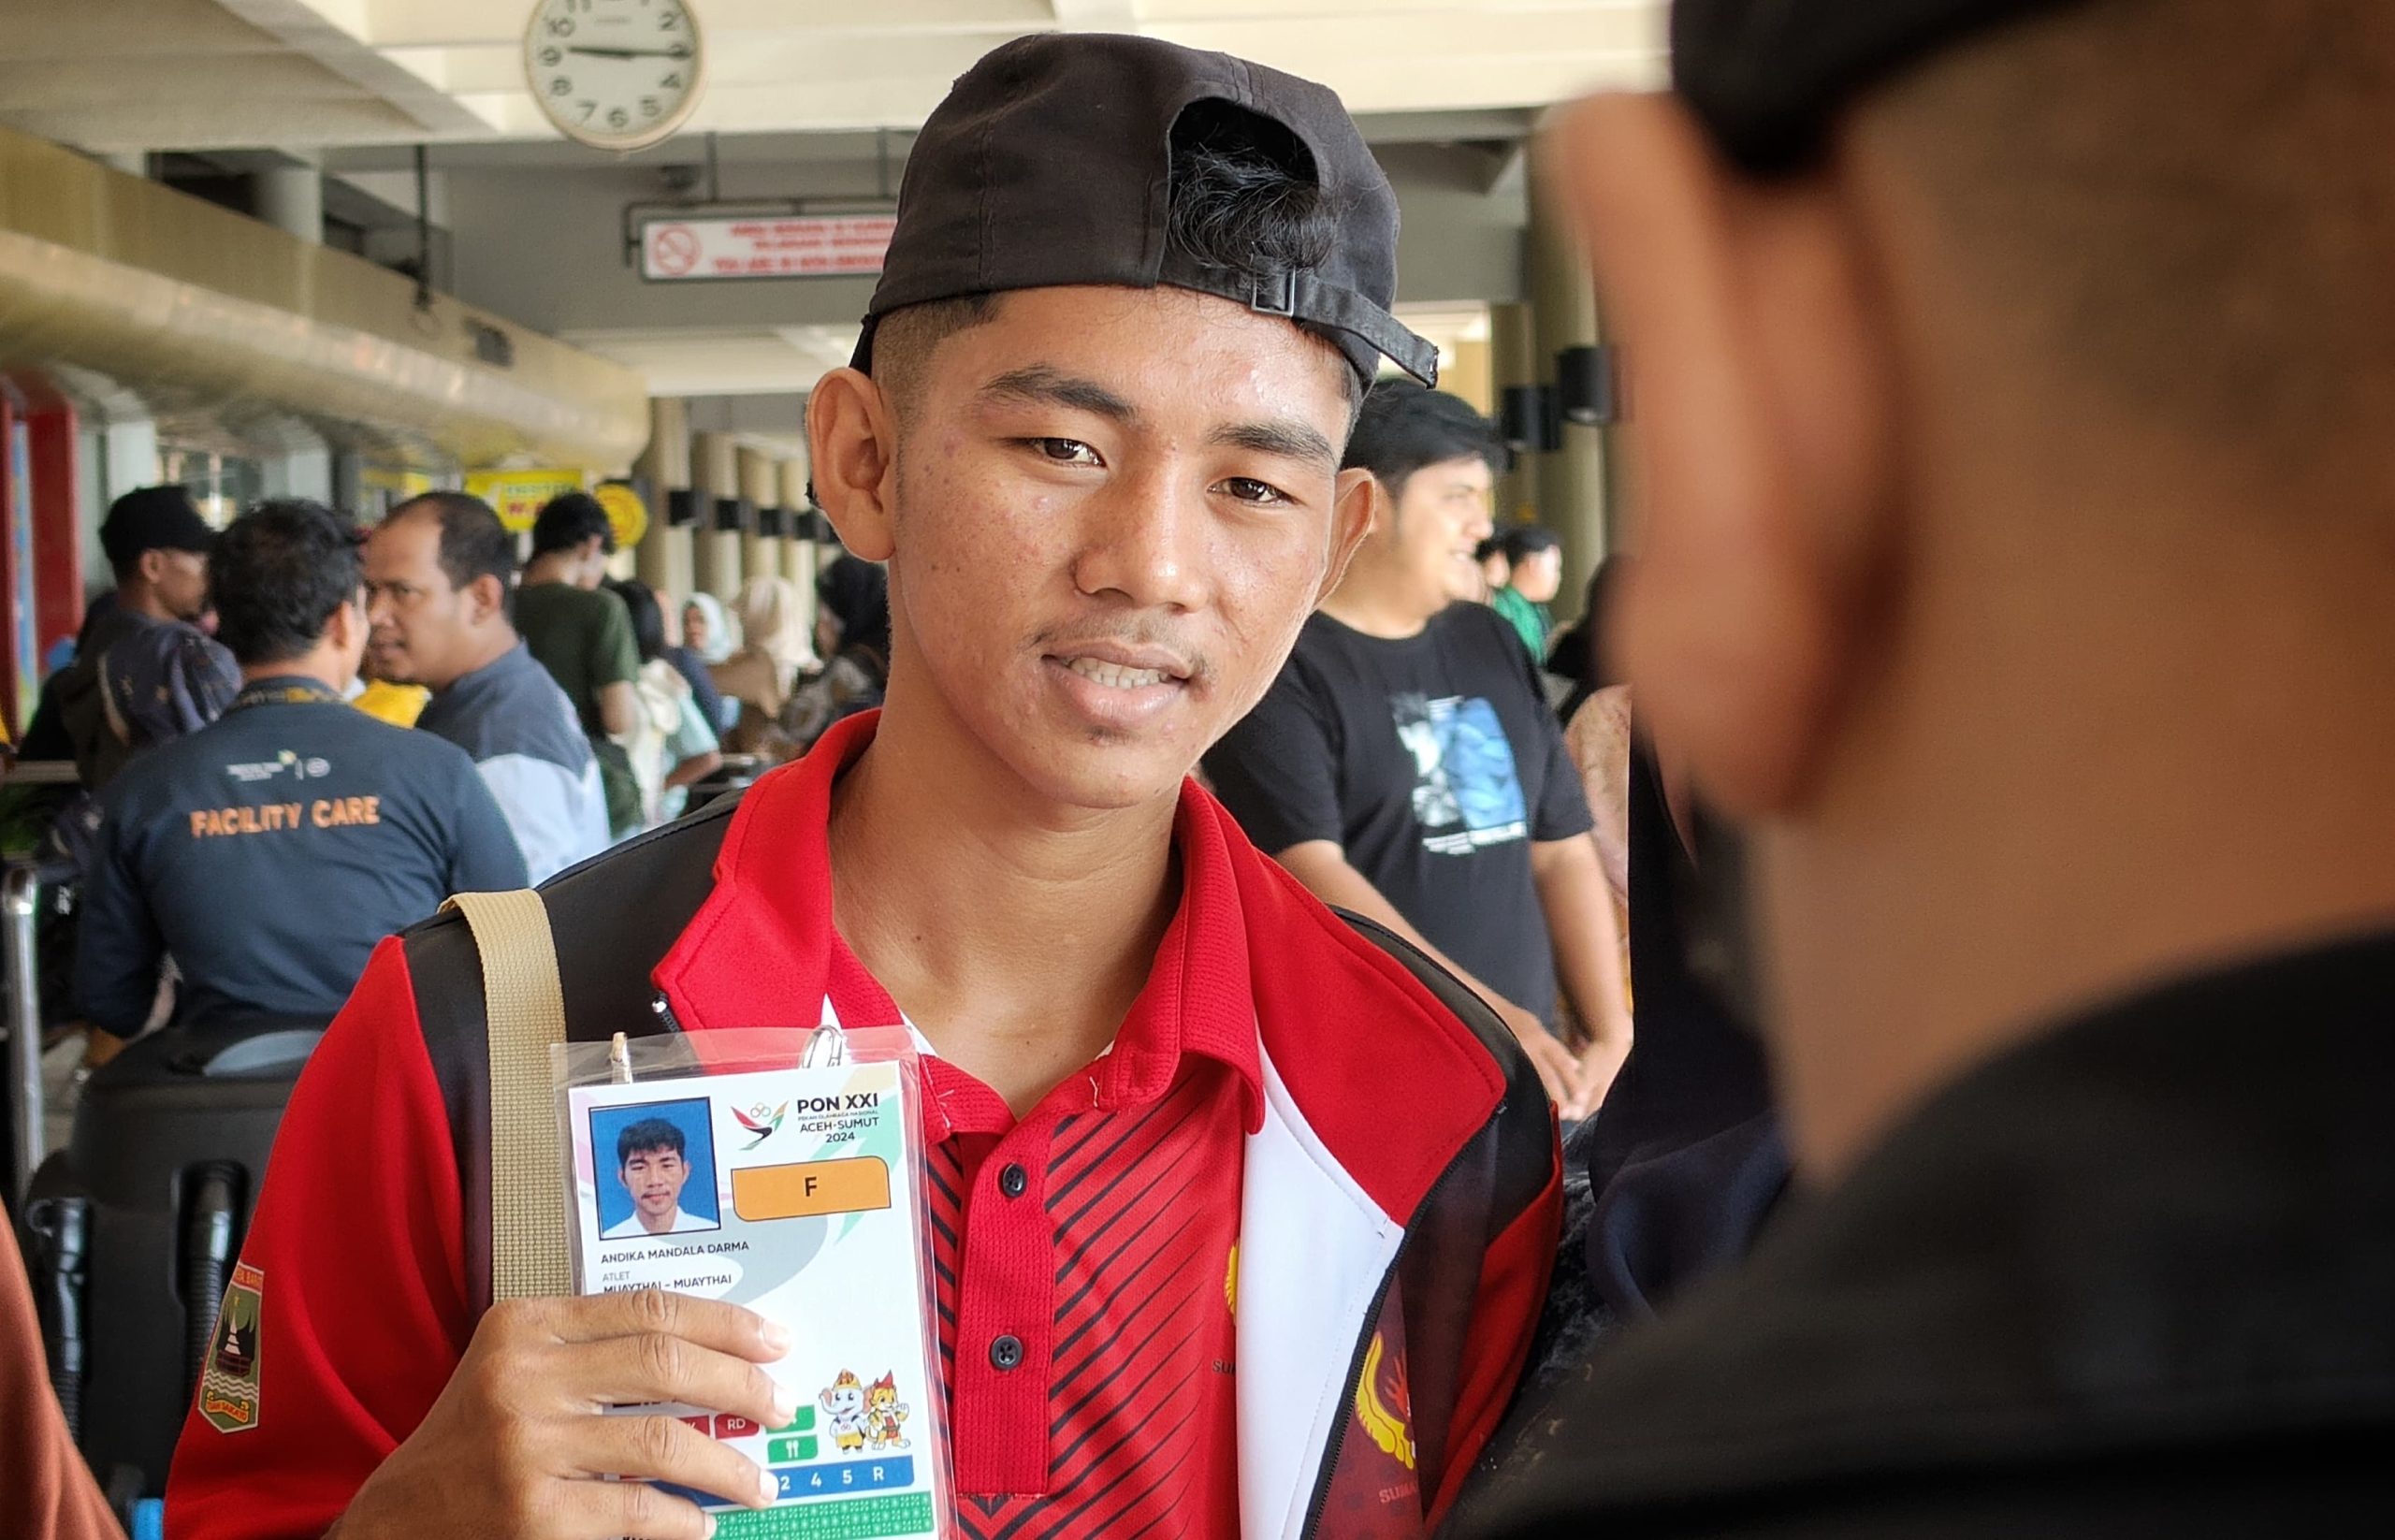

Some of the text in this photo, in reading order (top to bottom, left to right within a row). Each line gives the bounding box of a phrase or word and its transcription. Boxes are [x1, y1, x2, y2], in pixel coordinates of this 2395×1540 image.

[546, 16, 575, 37] 10
[659, 11, 677, 32] 2
[540, 48, 561, 67] 9
[551, 76, 573, 96] 8
[660, 74, 681, 89] 4
[577, 99, 599, 123] 7
[608, 107, 629, 127] 6
[641, 98, 660, 117] 5
[190, 796, 380, 838] FACILITY CARE
[797, 1093, 878, 1114] PON XXI
[825, 1131, 855, 1143] 2024
[805, 1176, 817, 1197] F
[601, 1241, 749, 1264] ANDIKA MANDALA DARMA
[602, 1271, 631, 1282] ATLET
[674, 1274, 732, 1289] MUAYTHAI
[727, 1417, 747, 1431] RD
[780, 1466, 884, 1490] 2 4 5 R
